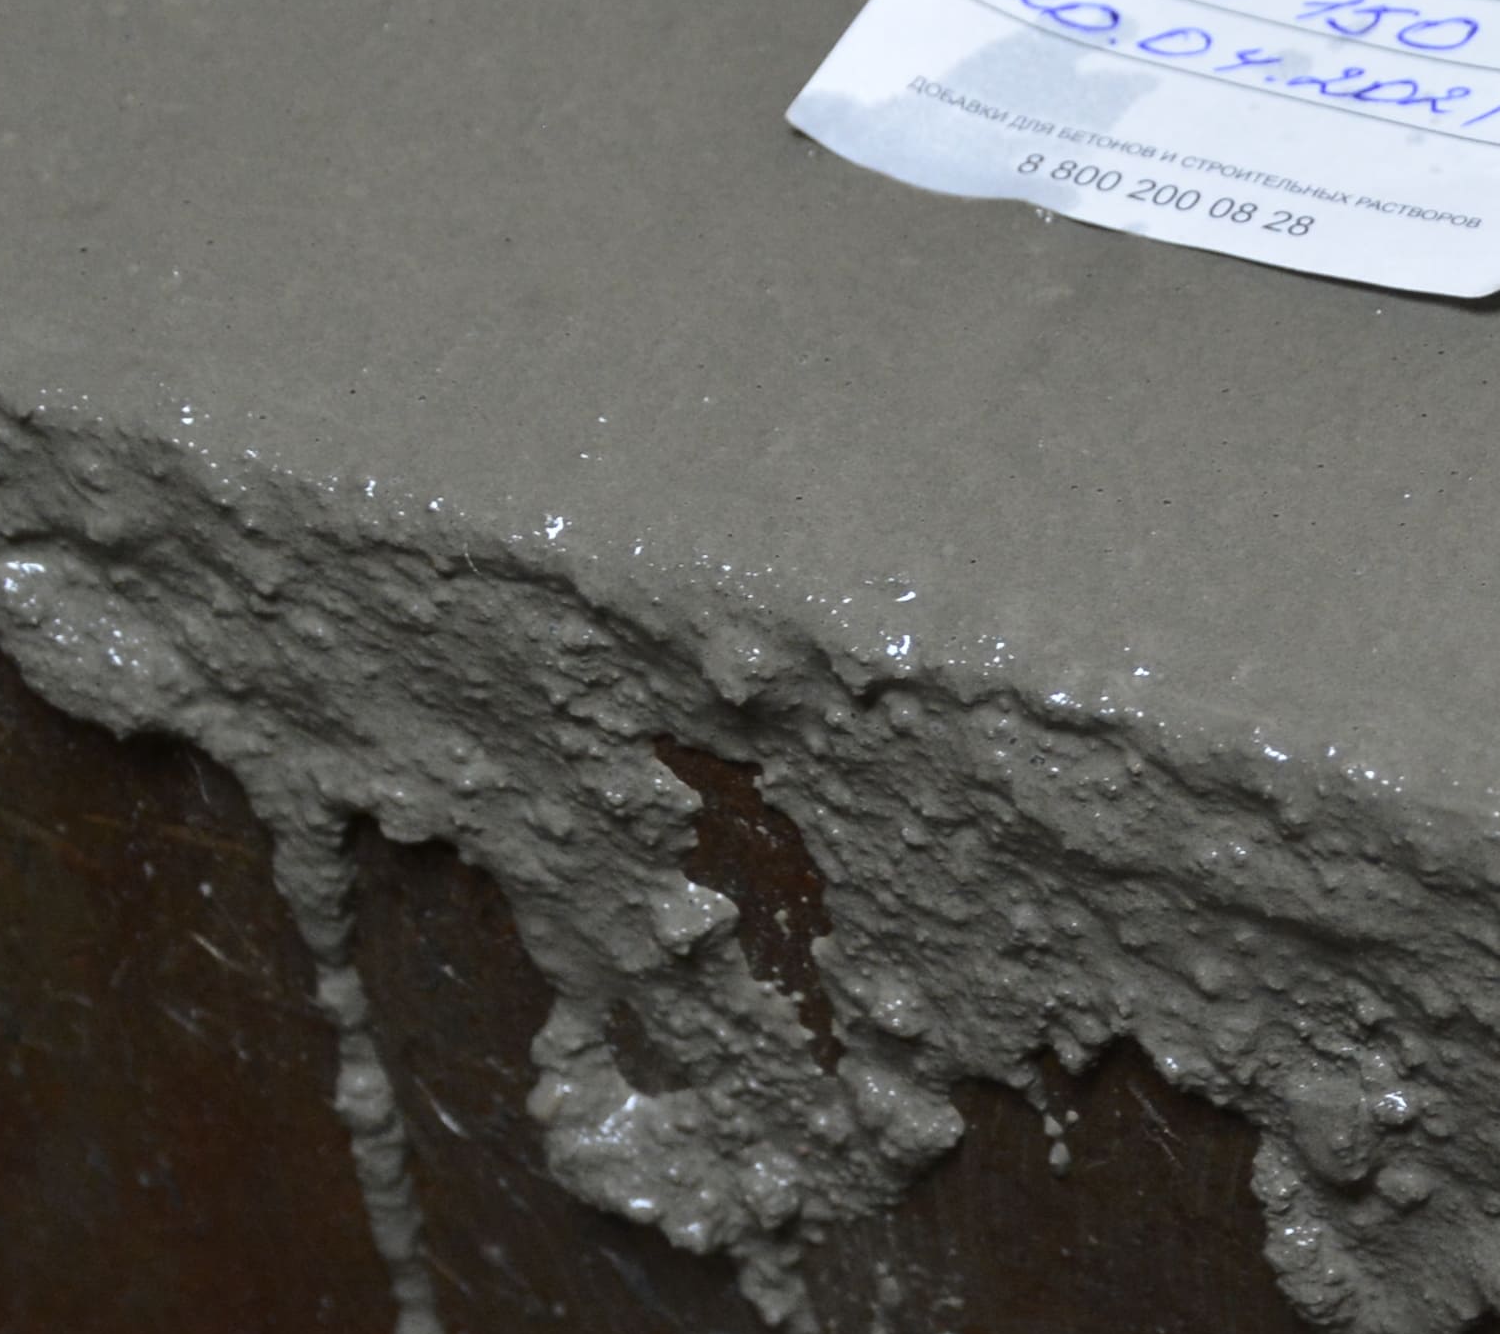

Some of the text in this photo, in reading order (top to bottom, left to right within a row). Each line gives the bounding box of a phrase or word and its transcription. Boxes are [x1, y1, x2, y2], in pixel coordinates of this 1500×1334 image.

[907, 75, 1483, 230] ДОБАВКИ ДЛЯ БЕТОНОВ И СТРОИТЕЛЬНЫХ РАСТВОРОВ
[1016, 152, 1316, 238] 8 800 200 08 28
